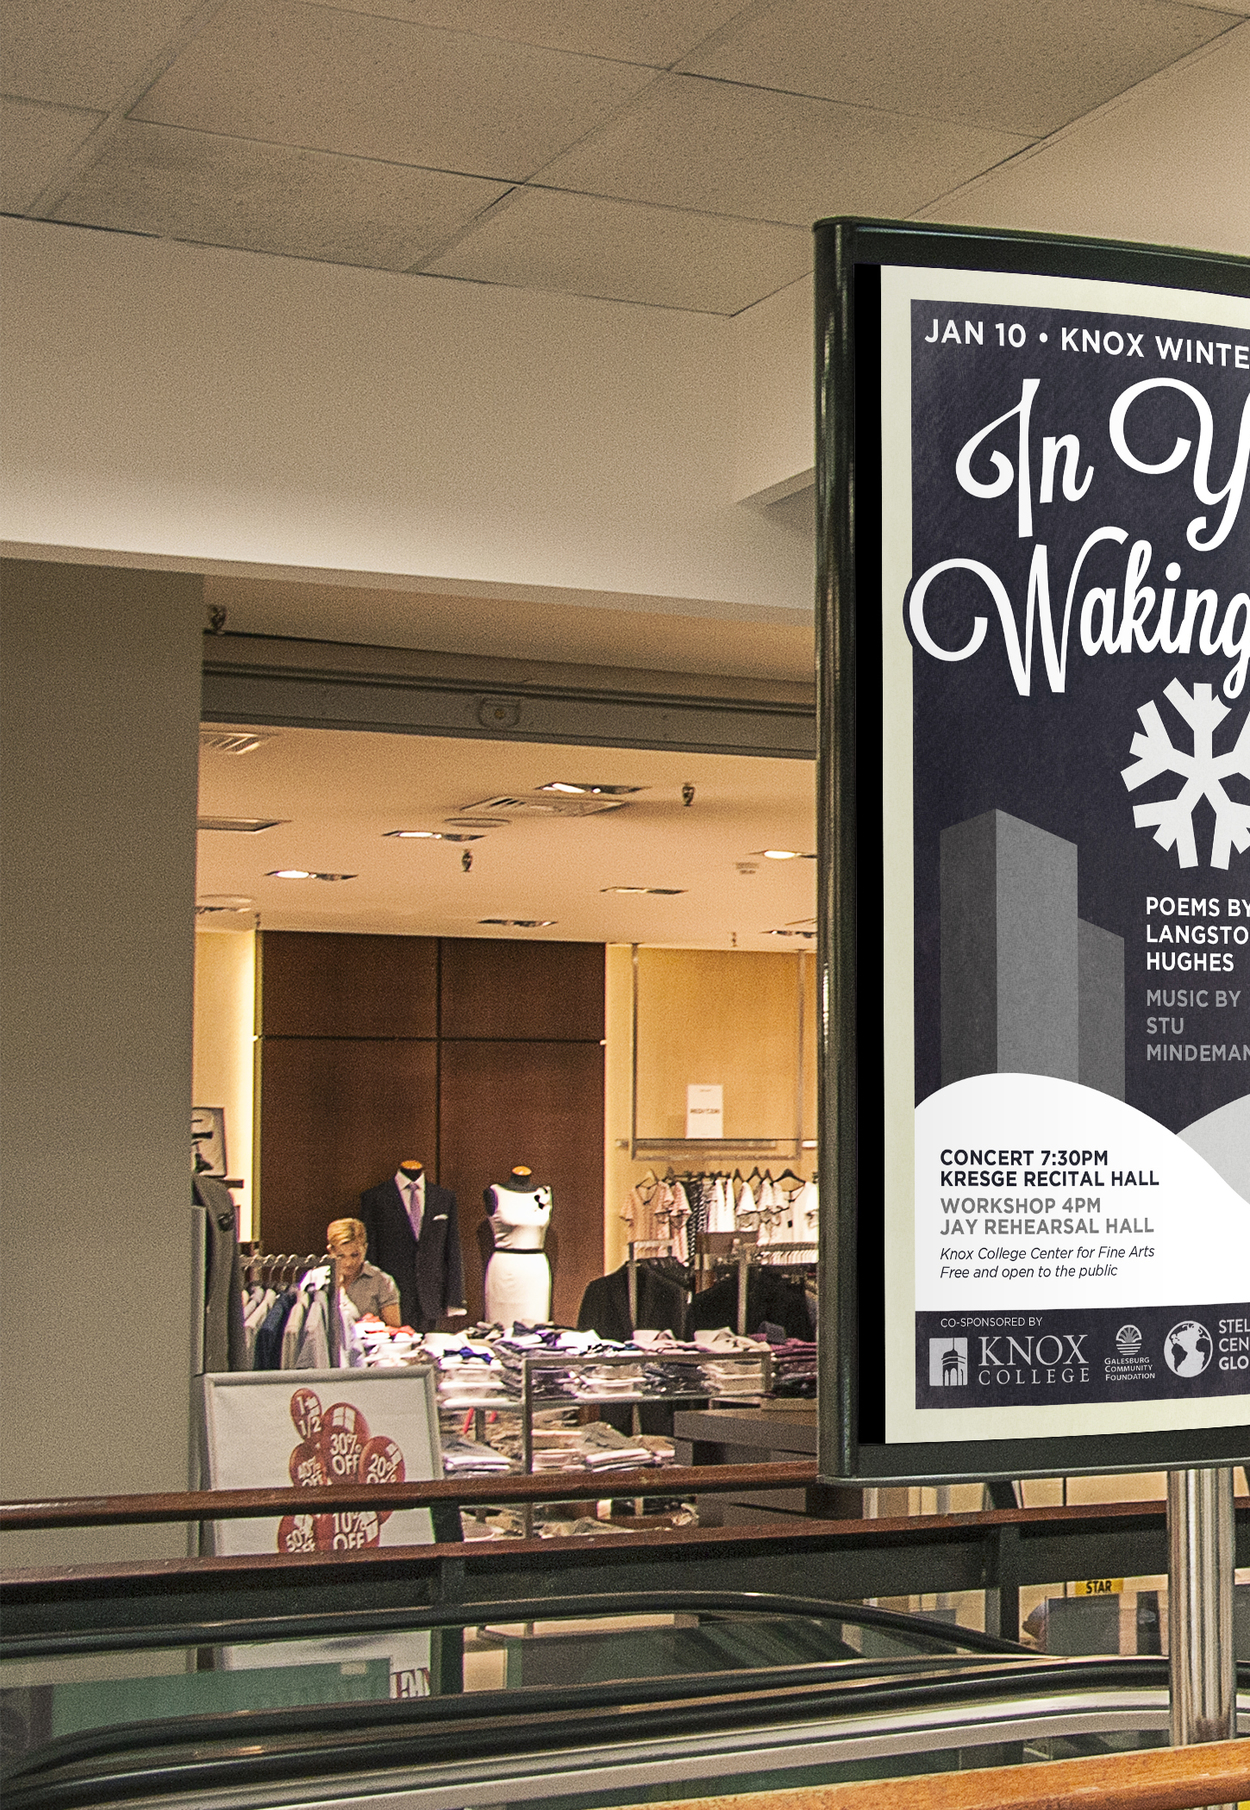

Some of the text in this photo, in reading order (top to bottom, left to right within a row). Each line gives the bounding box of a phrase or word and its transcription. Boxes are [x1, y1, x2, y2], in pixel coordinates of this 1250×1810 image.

[924, 319, 984, 345] JAN
[995, 323, 1027, 348] 10
[1060, 328, 1145, 358] KNOX
[955, 378, 1094, 538] In
[1146, 896, 1220, 917] POEMS
[1146, 951, 1234, 972] HUGHES
[1146, 989, 1241, 1007] MUSIC BY
[1146, 1017, 1184, 1034] STU
[940, 1149, 1108, 1166] CONCERT 7:30PM
[940, 1170, 1160, 1187] KRESGE RECITAL HALL
[940, 1197, 1101, 1214] WORKSHOP 4PM
[940, 1218, 1154, 1235] JAY REHEARSAL HALL
[940, 1245, 1155, 1262] Knox College Center for Fine Arts
[940, 1264, 1118, 1280] Free and open to the public
[940, 1317, 1043, 1328] CO-SPONSORED BY
[978, 1334, 1090, 1367] KNOX
[1104, 1357, 1150, 1365] GALESBURG
[1104, 1364, 1153, 1373] COMMUNITY
[978, 1367, 1090, 1385] COLLEGE
[1105, 1372, 1156, 1382] FOUNDATION
[330, 1433, 362, 1455] 30%
[332, 1455, 360, 1475] OFF
[368, 1454, 397, 1483] 20%
[332, 1512, 366, 1534] 10%
[334, 1532, 365, 1550] OFF
